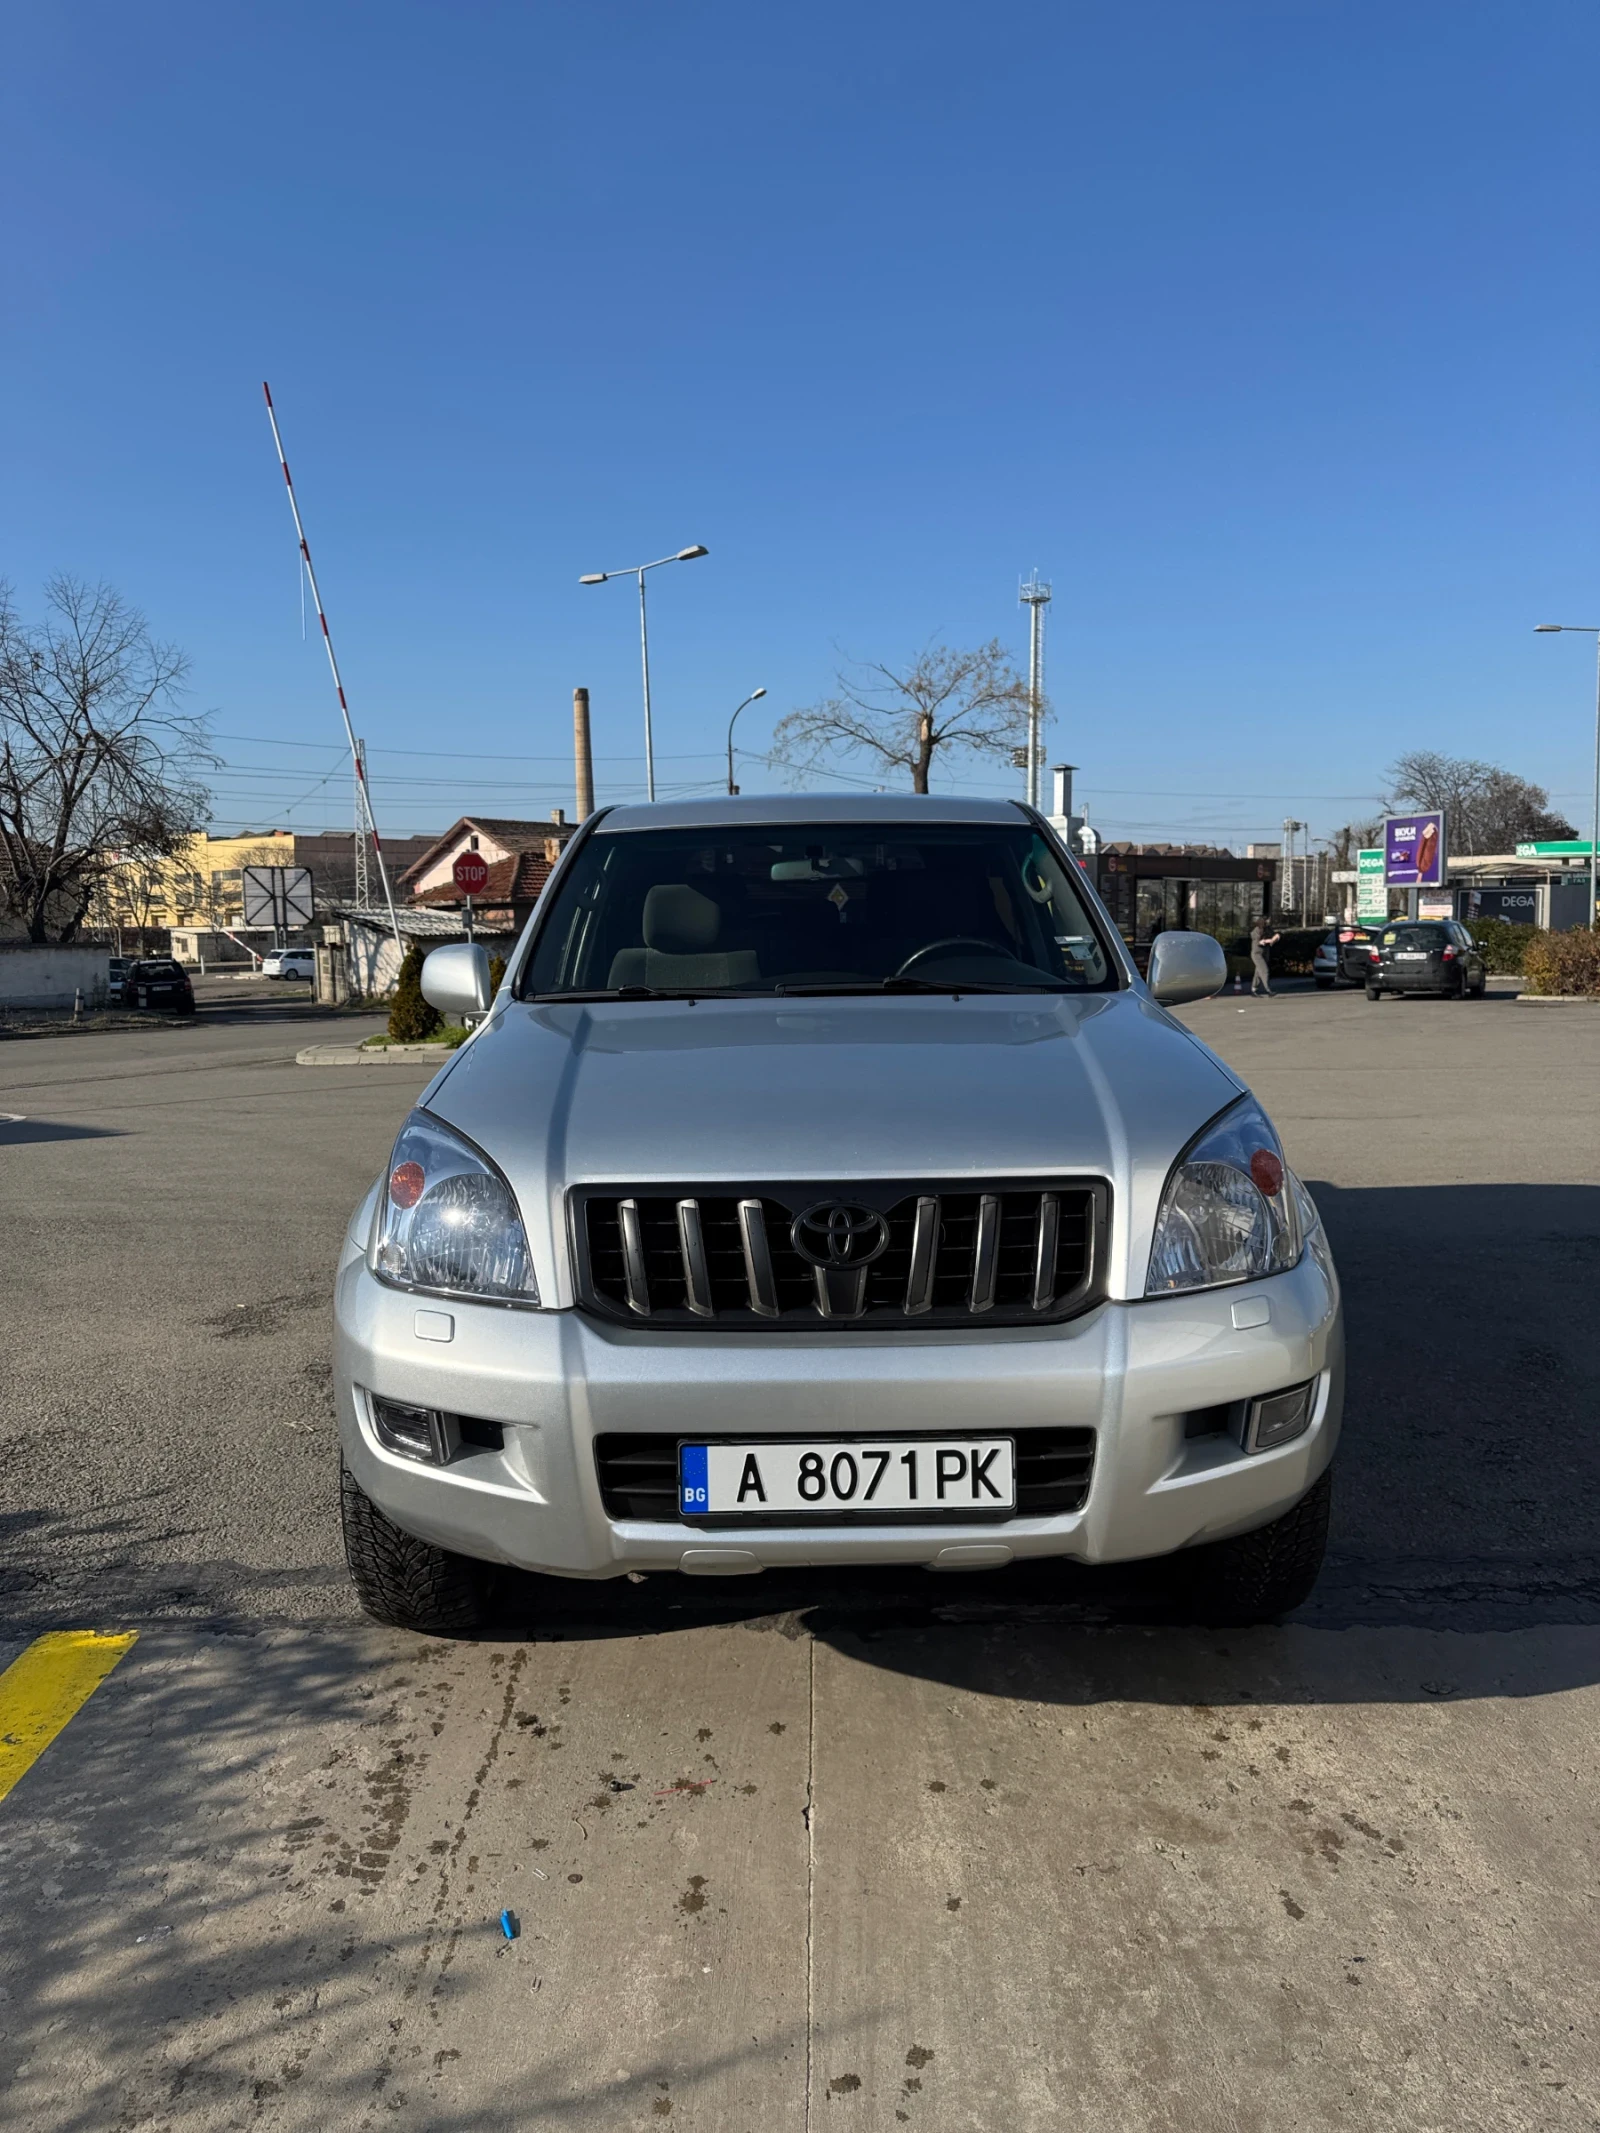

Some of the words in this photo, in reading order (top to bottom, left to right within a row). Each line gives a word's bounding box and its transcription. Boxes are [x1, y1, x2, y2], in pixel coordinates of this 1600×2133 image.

[456, 866, 486, 881] STOP
[1501, 896, 1535, 907] DEGA
[736, 1453, 767, 1503] A
[684, 1488, 706, 1503] BG
